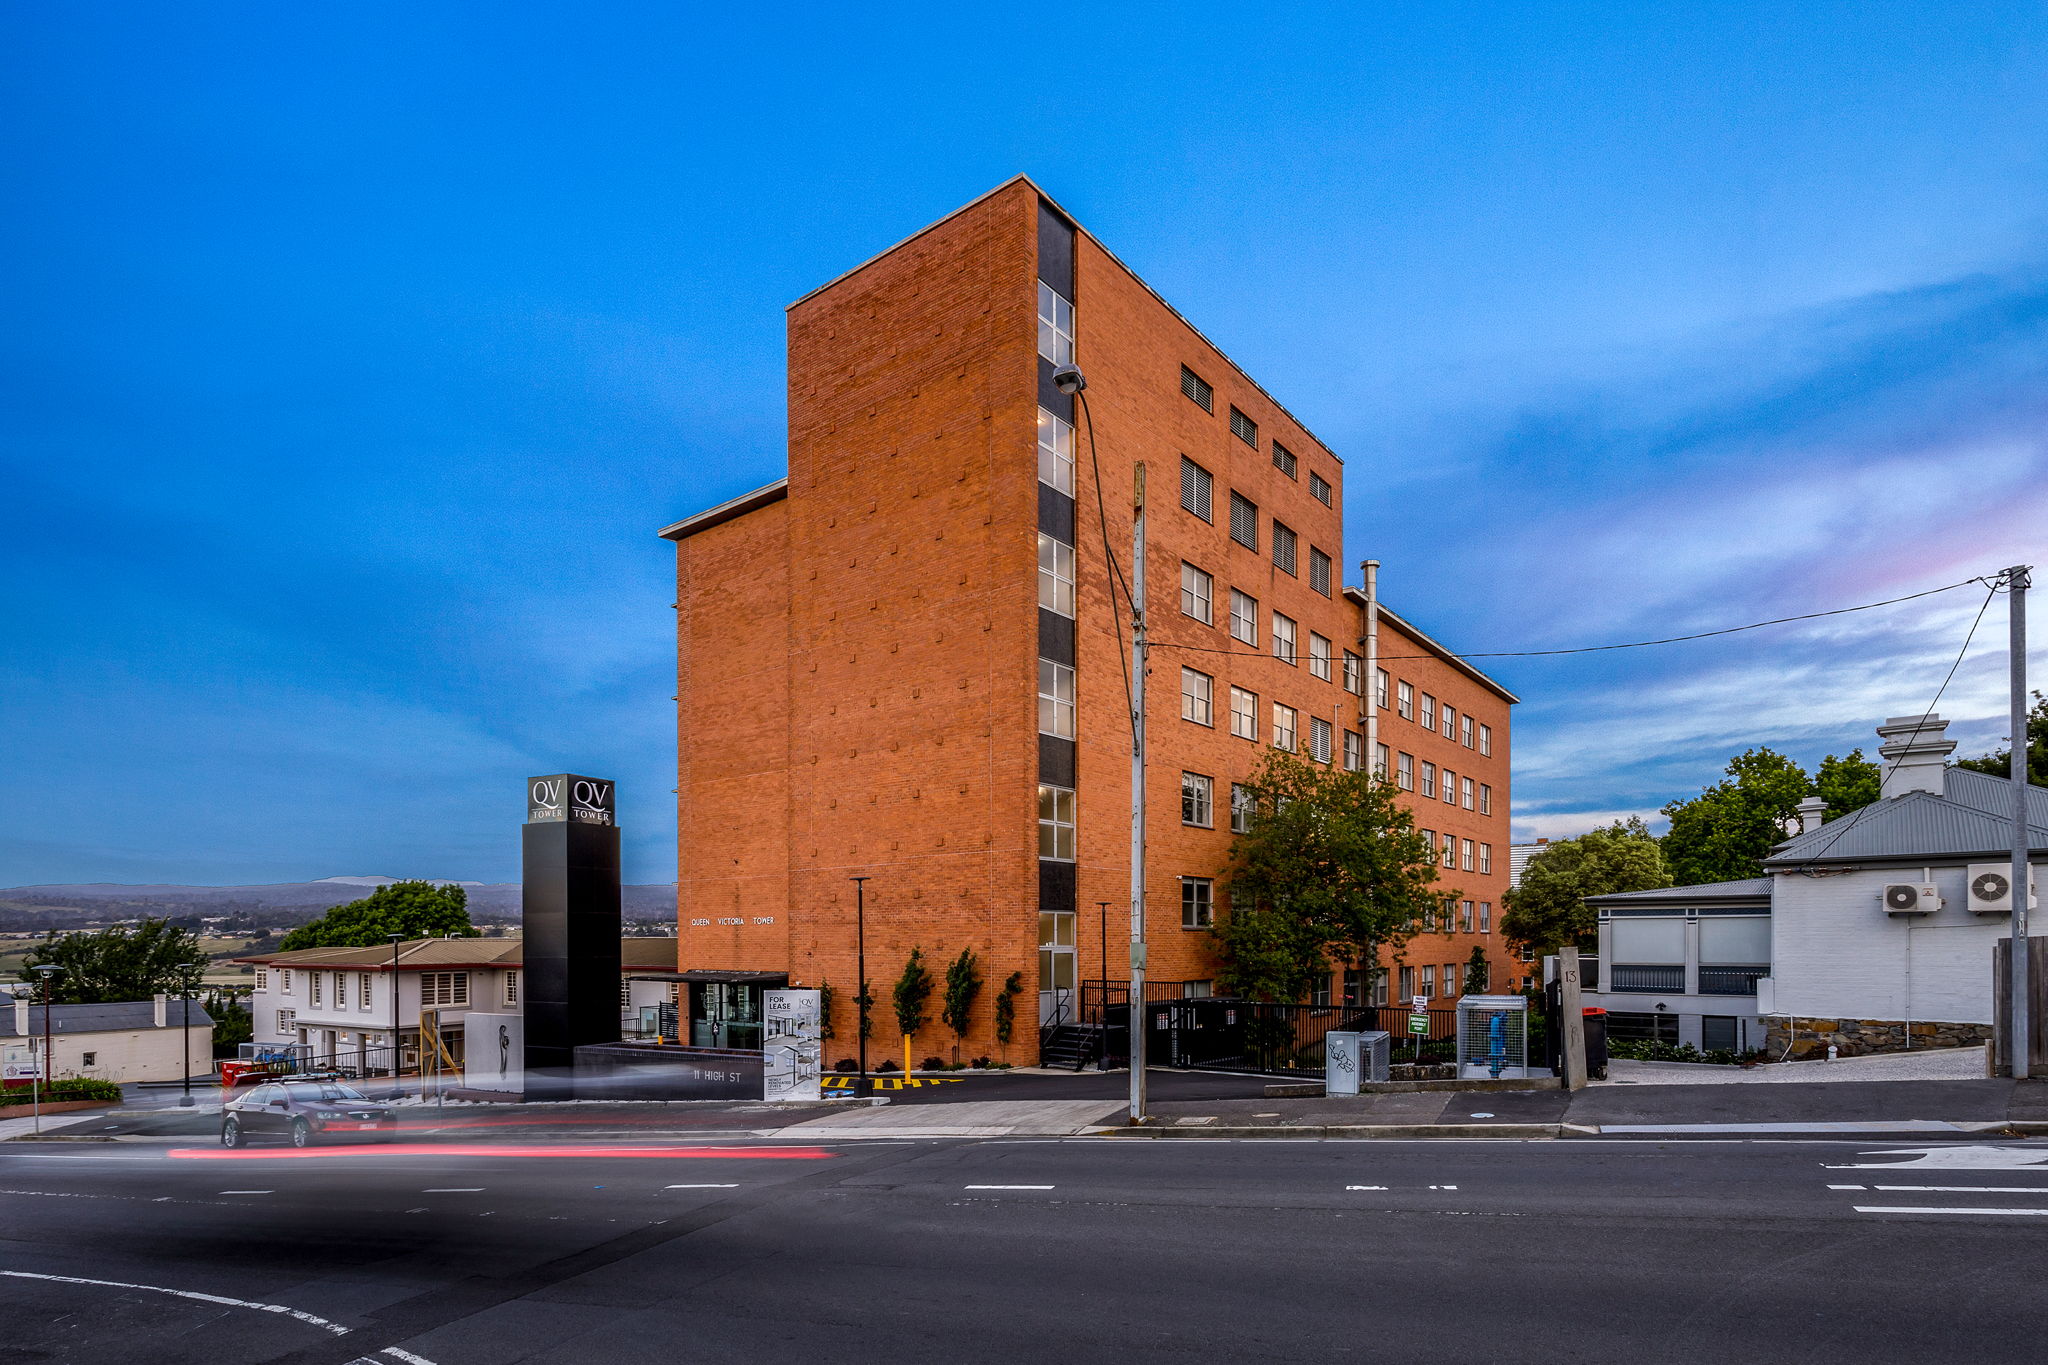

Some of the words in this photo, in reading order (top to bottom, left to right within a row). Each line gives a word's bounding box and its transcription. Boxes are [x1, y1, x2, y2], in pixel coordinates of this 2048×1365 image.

[533, 780, 562, 809] QV
[573, 781, 609, 812] QV
[533, 809, 562, 819] TOWER
[573, 809, 609, 821] TOWER
[691, 918, 710, 926] QUEEN
[717, 917, 744, 925] VICTORIA
[753, 916, 774, 925] TOWER
[1565, 970, 1577, 983] 13
[801, 999, 814, 1007] QV
[694, 1069, 700, 1080] 11
[704, 1070, 725, 1082] HIGH
[729, 1072, 742, 1083] ST
